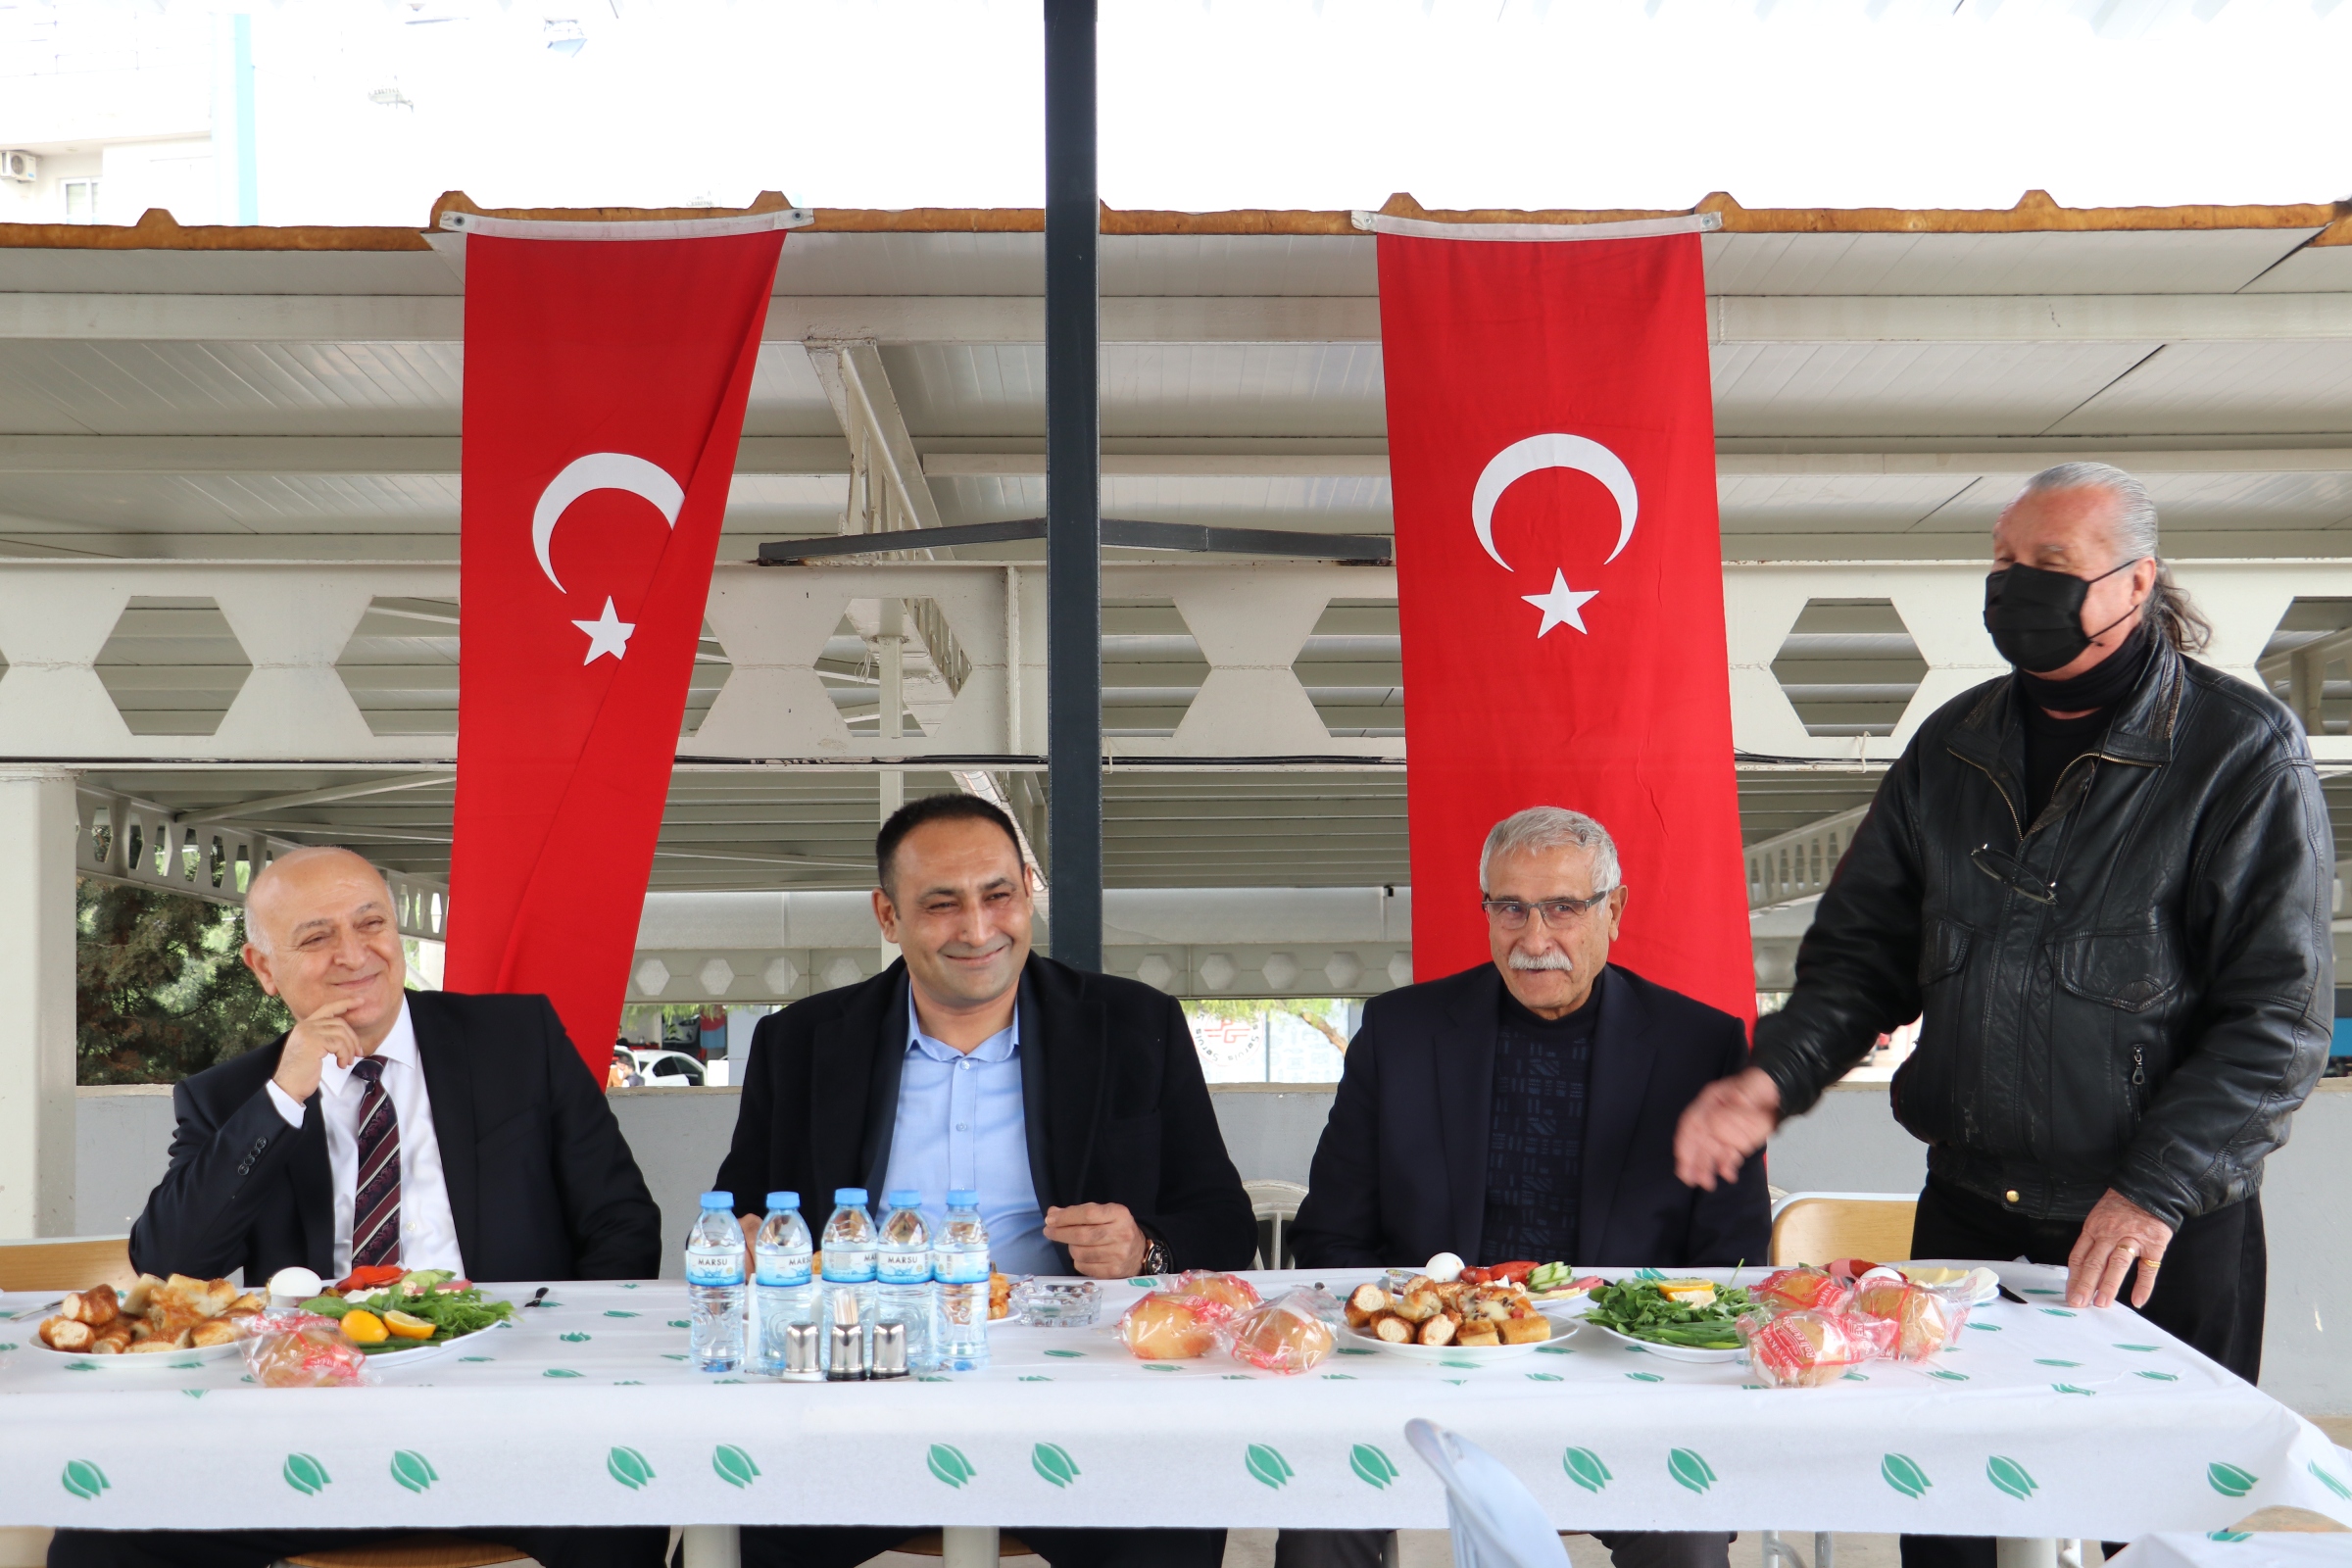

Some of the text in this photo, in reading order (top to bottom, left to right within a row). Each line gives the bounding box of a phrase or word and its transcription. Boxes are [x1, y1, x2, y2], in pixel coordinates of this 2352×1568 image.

[698, 1257, 728, 1266] MARSU
[788, 1256, 812, 1266] MARS
[887, 1255, 918, 1264] MARSU
[1798, 1341, 1816, 1359] Roll
